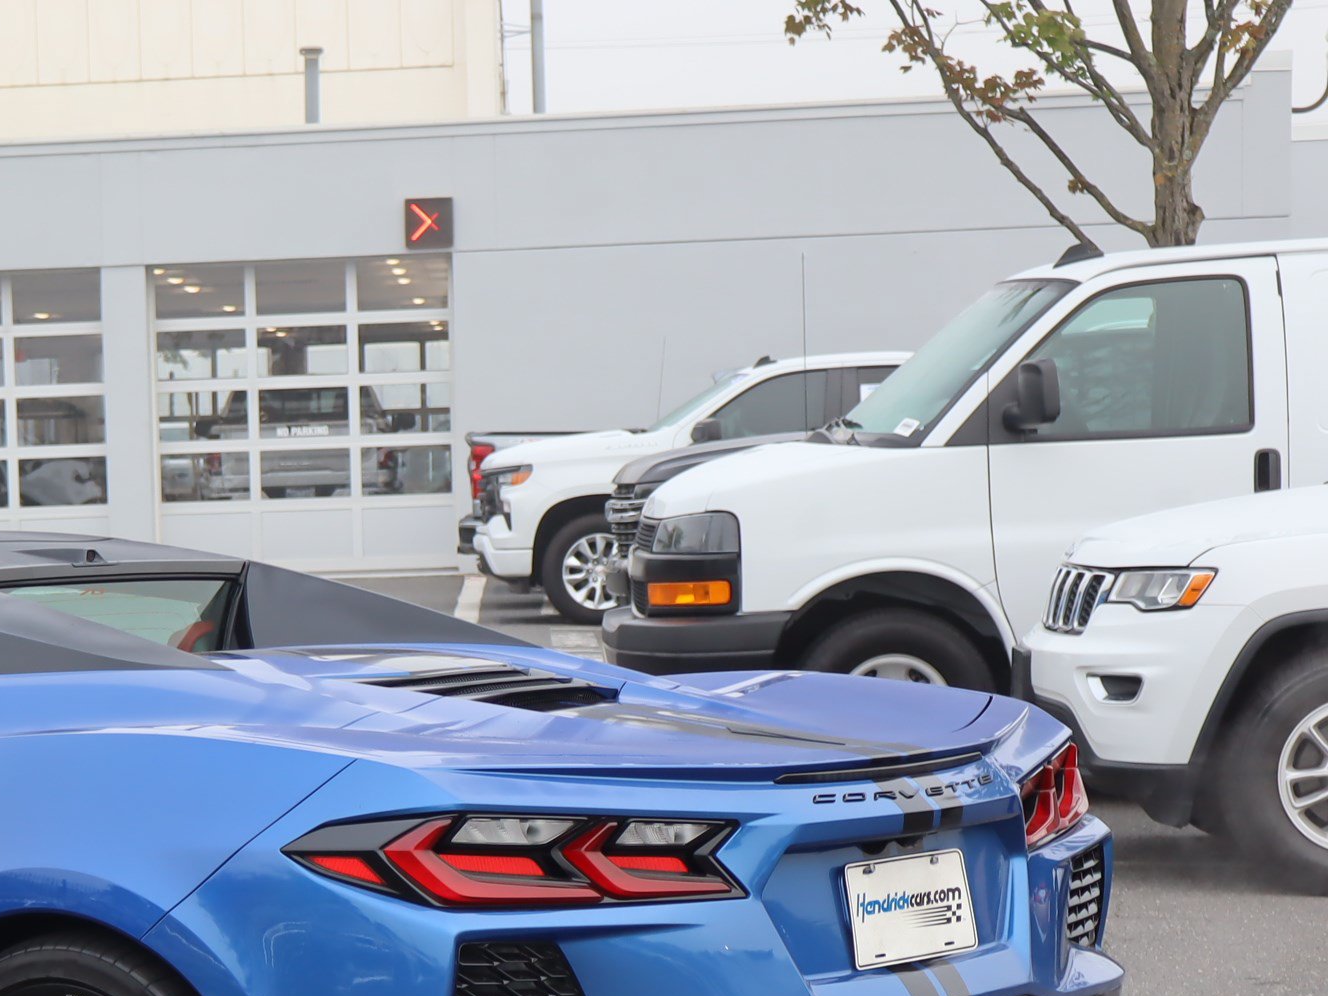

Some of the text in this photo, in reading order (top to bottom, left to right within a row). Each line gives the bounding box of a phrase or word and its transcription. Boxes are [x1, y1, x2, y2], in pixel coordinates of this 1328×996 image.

[276, 425, 329, 437] NO PARKING
[813, 774, 993, 804] CORVETTE
